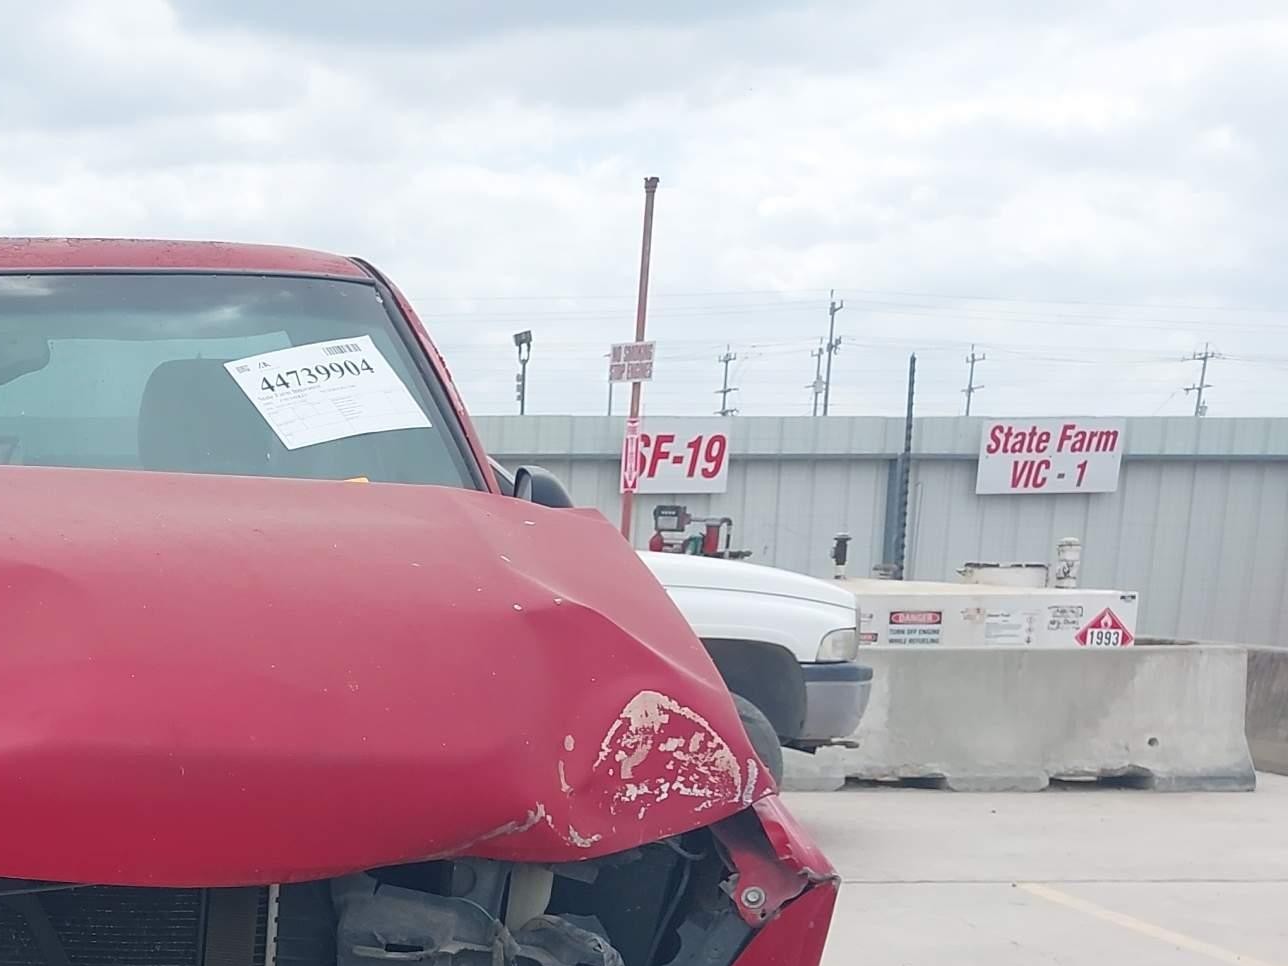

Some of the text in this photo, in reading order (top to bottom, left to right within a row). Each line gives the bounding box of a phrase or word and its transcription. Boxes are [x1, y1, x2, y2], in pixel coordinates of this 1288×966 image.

[261, 358, 375, 392] 44739904
[986, 424, 1119, 454] State Farm
[638, 434, 727, 479] SF-19
[1011, 459, 1051, 488] VIC
[1075, 459, 1088, 487] 1
[1090, 630, 1120, 646] 1993
